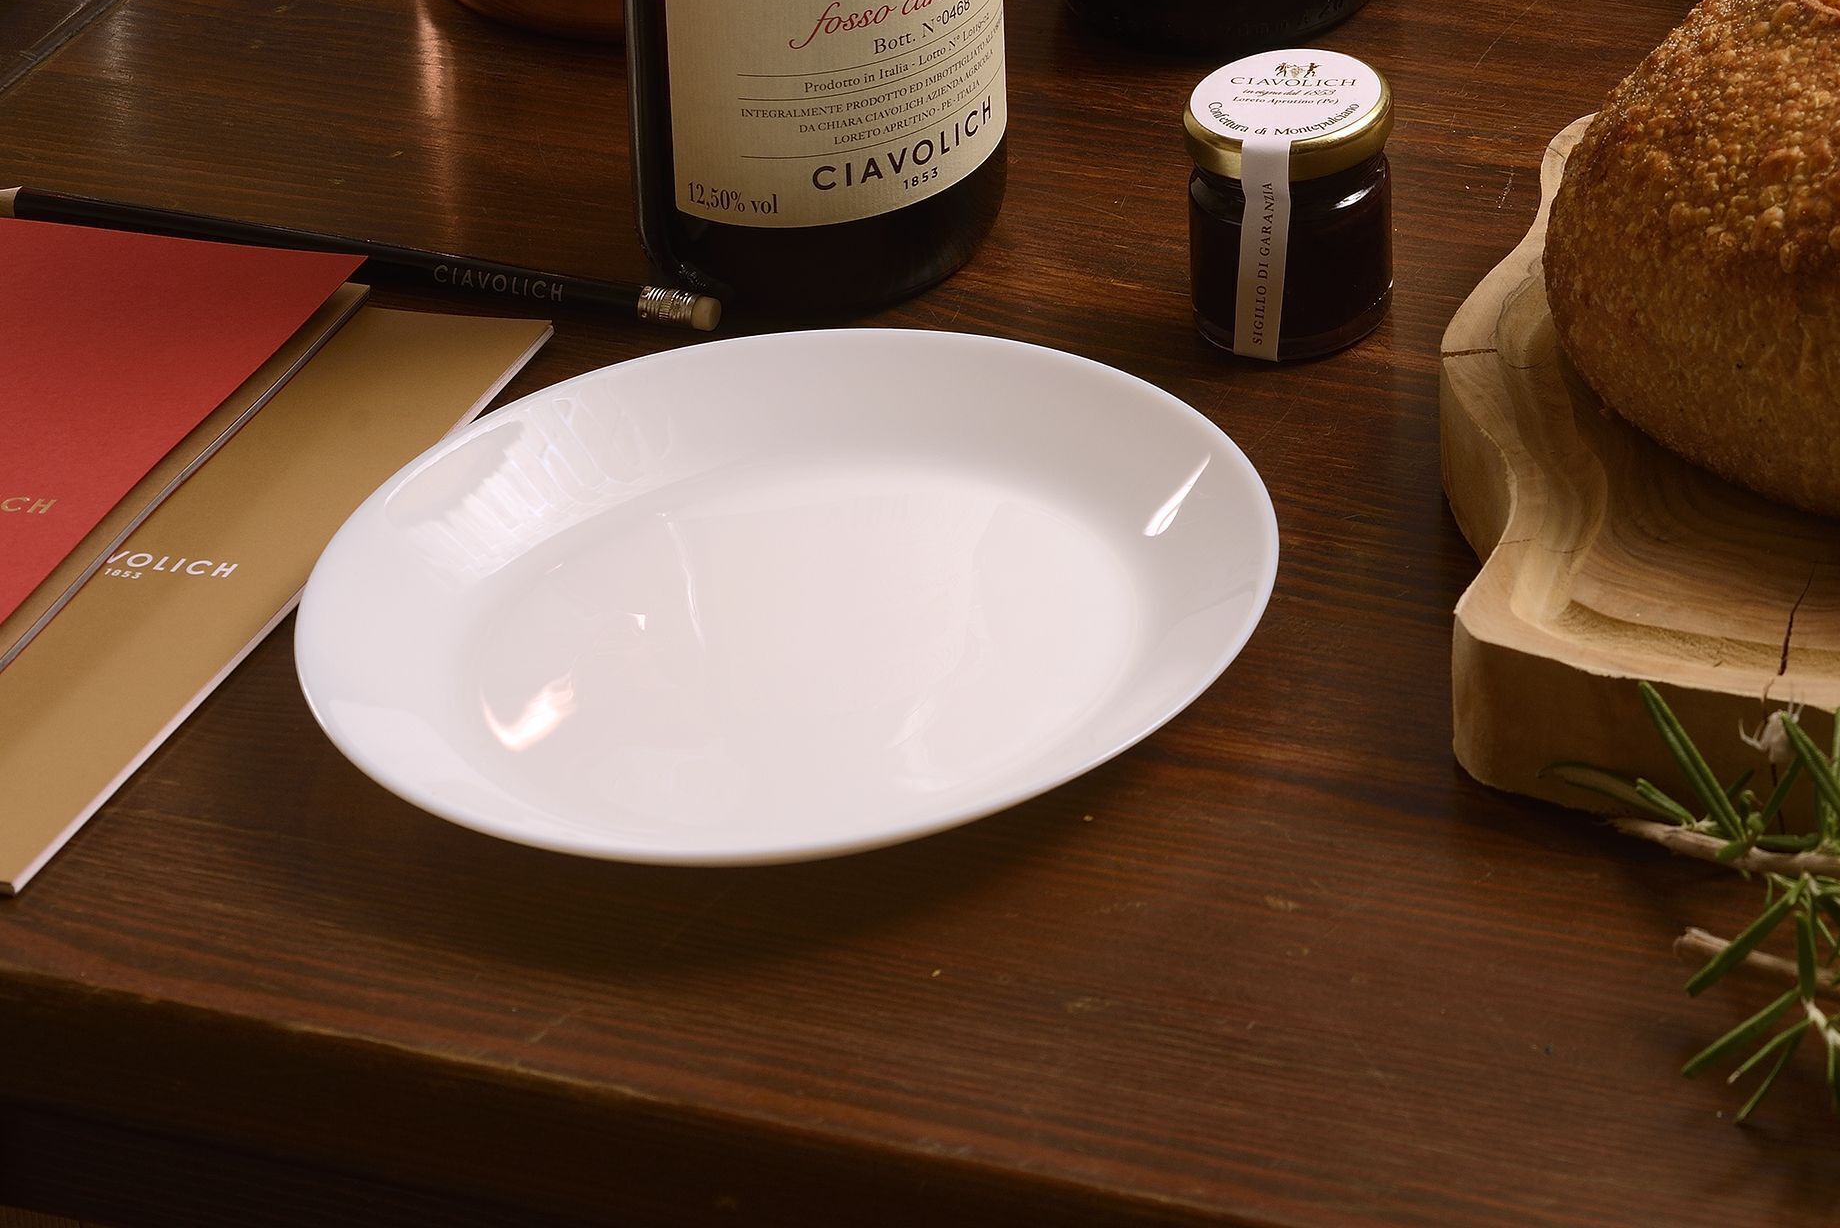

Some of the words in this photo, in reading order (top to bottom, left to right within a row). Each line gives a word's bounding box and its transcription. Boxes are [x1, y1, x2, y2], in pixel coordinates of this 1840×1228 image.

[789, 1, 897, 50] fosso
[873, 33, 916, 55] Bott.
[741, 102, 843, 118] INTEGRALMENTE
[846, 87, 907, 112] PRODOTTO
[909, 81, 924, 94] ED
[925, 41, 985, 88] IMBOTTIGLIATO
[804, 75, 860, 93] Prodotto
[863, 71, 875, 83] in
[879, 63, 909, 80] Italia
[919, 47, 946, 66] Lotto
[1230, 76, 1357, 87] CIAVOLICH
[799, 121, 815, 134] DA
[817, 115, 863, 132] CHIARA
[865, 97, 924, 123] CIAVOLICH
[925, 76, 964, 103] AZIENDA
[964, 48, 993, 79] AGRICOLA
[1232, 96, 1266, 104] Loreto
[1267, 98, 1314, 106] Aprutino
[1316, 97, 1340, 106] (Pe)
[834, 128, 881, 145] LORETO
[883, 107, 936, 135] APRUTINO
[941, 98, 952, 111] PE
[956, 79, 980, 102] ITALIA
[1208, 101, 1250, 133] Confettura
[1254, 127, 1267, 136] di
[1274, 103, 1360, 136] Montepulciano
[812, 95, 992, 191] CIAVOLICH
[903, 167, 939, 190] 1853
[687, 180, 746, 213] 12,50%
[750, 193, 778, 215] vol
[1260, 181, 1274, 257] GARANZIA
[434, 264, 563, 302] CIAVOLICH
[1258, 262, 1269, 280] DI
[1252, 285, 1267, 346] SIGILLO
[104, 567, 143, 580] 1853
[106, 550, 239, 578] VOLICH
